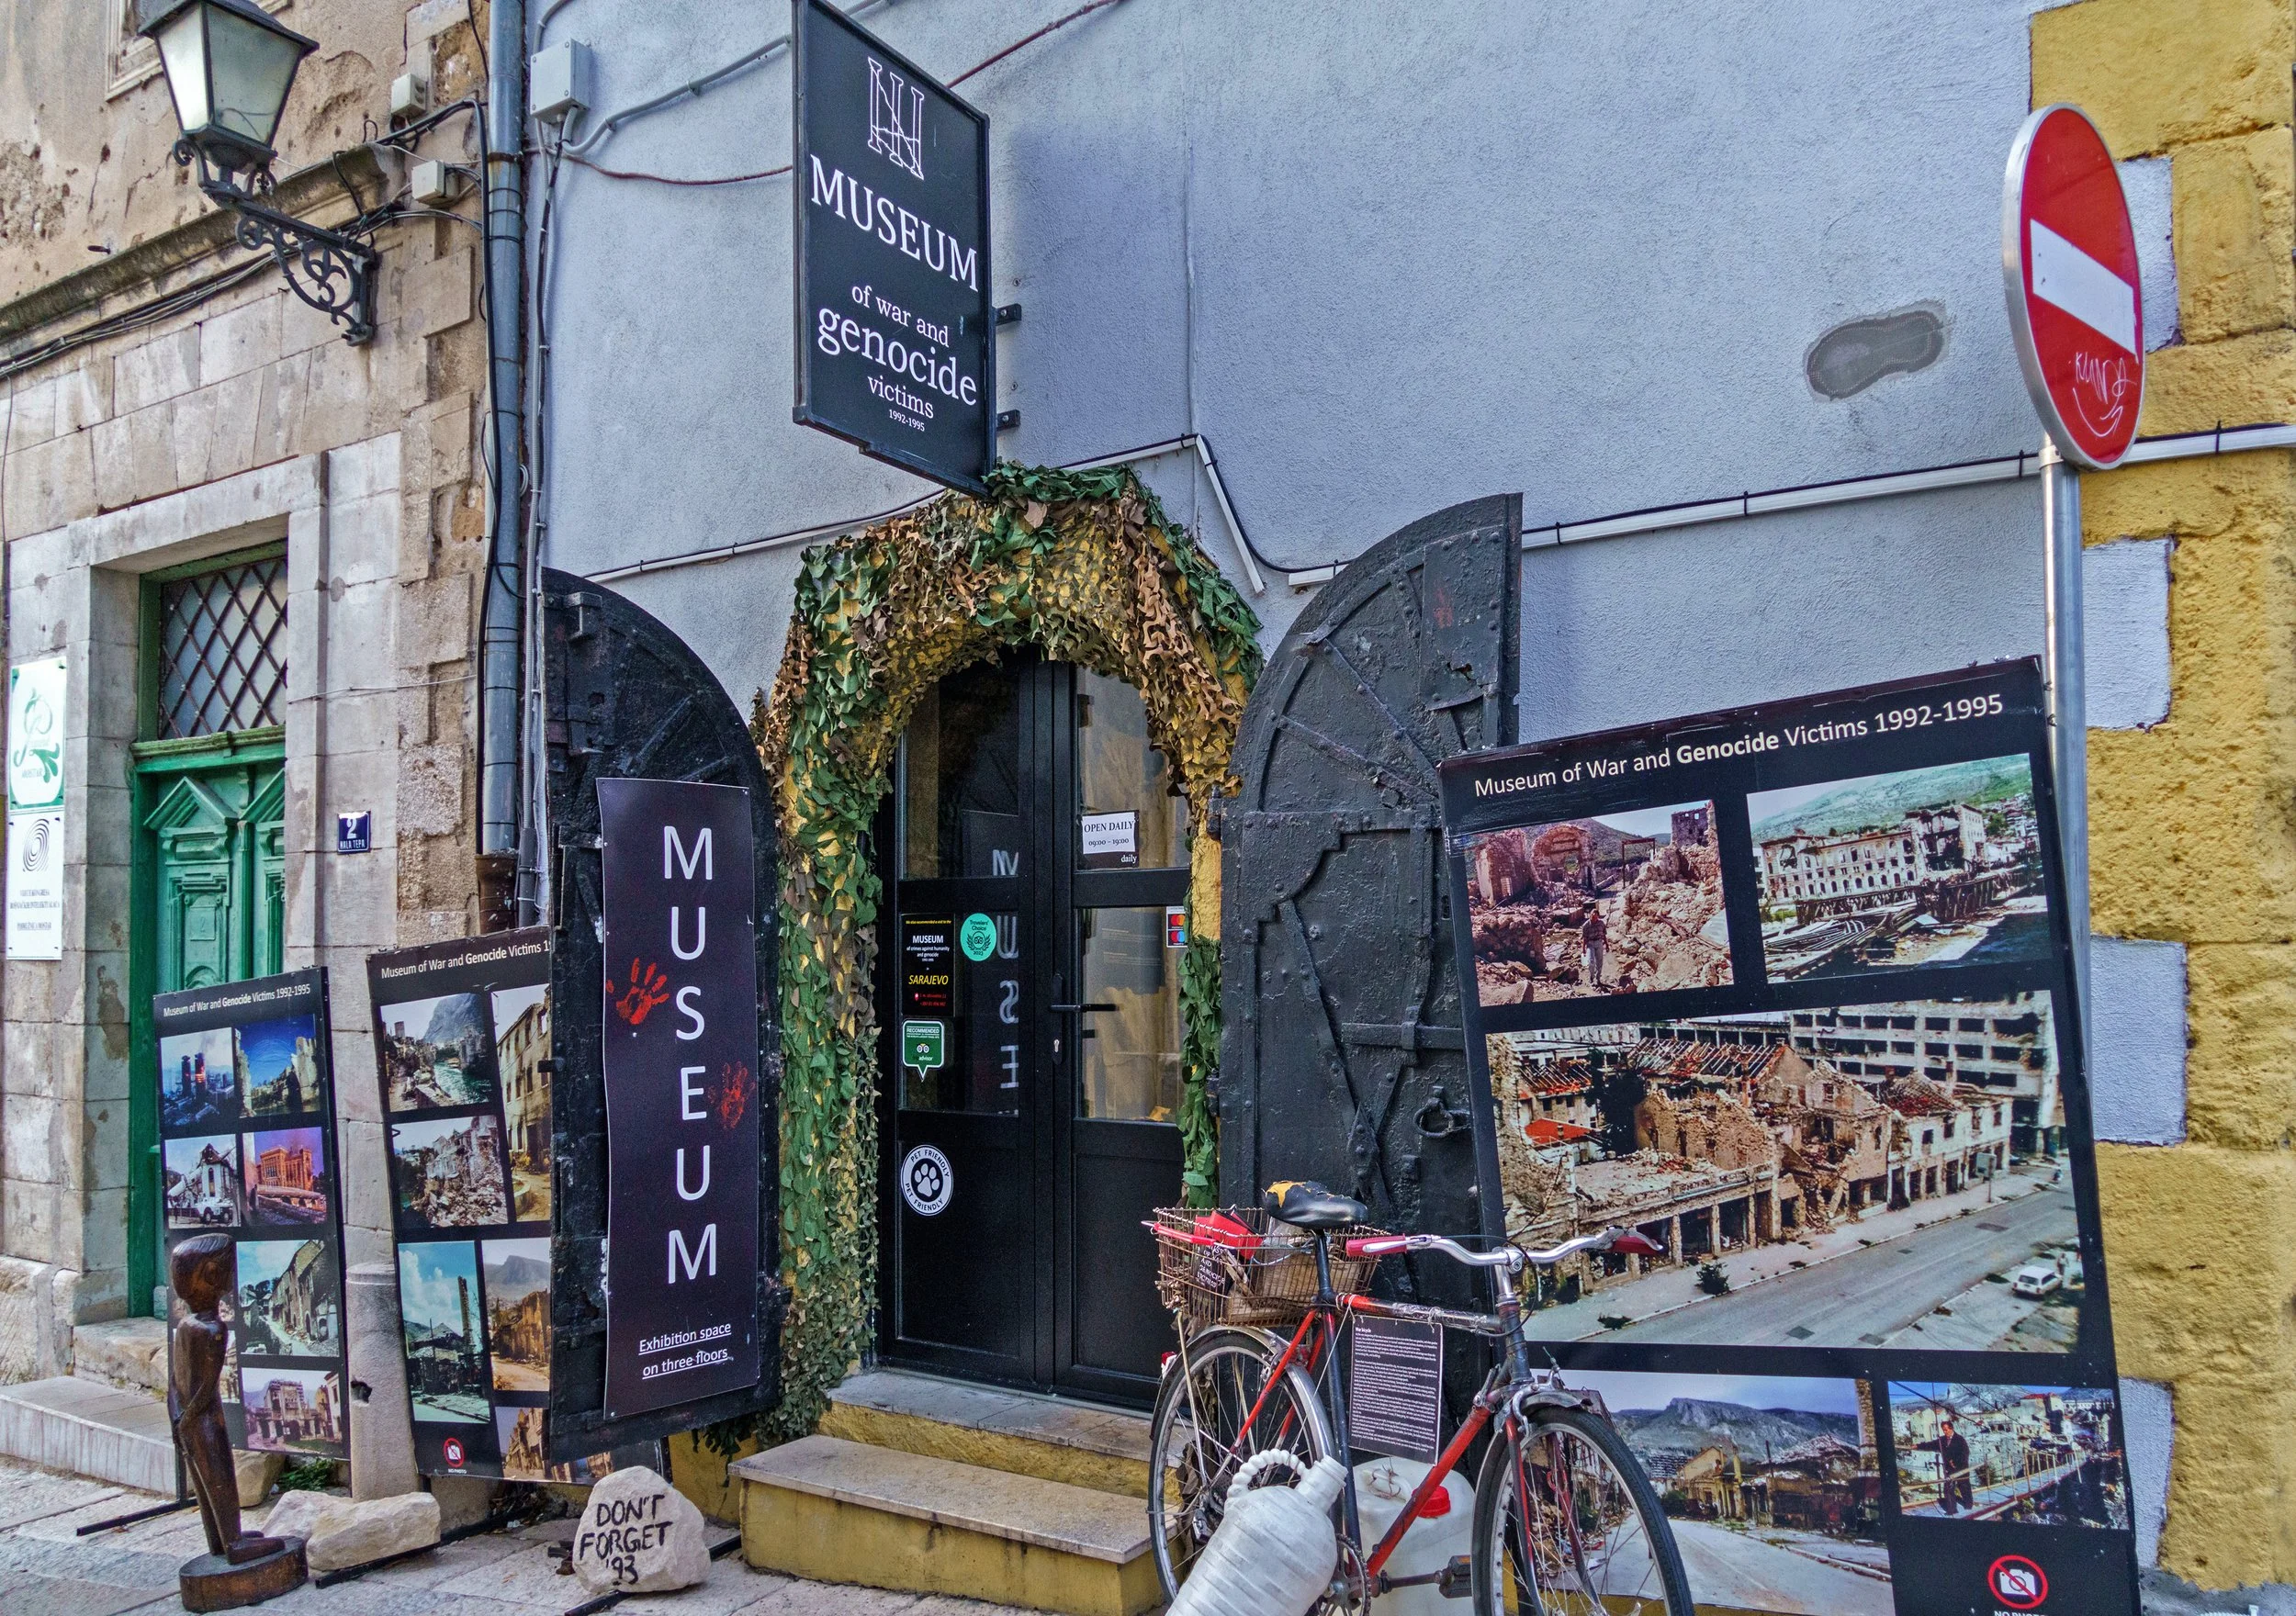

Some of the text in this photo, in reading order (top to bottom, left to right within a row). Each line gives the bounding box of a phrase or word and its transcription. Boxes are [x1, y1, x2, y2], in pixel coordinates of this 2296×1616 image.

[810, 154, 979, 293] MUSEUM
[851, 285, 950, 348] of war and
[817, 308, 977, 407] genocide
[867, 376, 935, 420] victims
[888, 409, 926, 432] 1992-1995
[1474, 693, 2004, 797] Museum of War and Genocide Victims 1992-1995
[346, 816, 357, 839] 2
[1084, 820, 1135, 833] OPEN DAILY
[1088, 839, 1107, 847] 09:00
[1120, 854, 1137, 864] daily
[912, 935, 943, 943] MUSEUM
[381, 965, 416, 979] Museum
[418, 960, 428, 972] of
[428, 960, 445, 971] War
[447, 954, 464, 968] and
[465, 948, 507, 964] Genocide
[508, 942, 541, 958] Victims
[908, 974, 949, 985] SARAJEVO
[163, 983, 310, 1016] Museum of War and Genocide Victims 1992-1995
[664, 825, 716, 1284] MUSEUM
[910, 1149, 950, 1177] PET FRIENDLY
[905, 1183, 943, 1211] PET FRIENDLY
[639, 1323, 731, 1352] Exhibition space
[643, 1349, 728, 1376] on three floors
[580, 1521, 673, 1561] FORGET
[606, 1554, 638, 1585] '93
